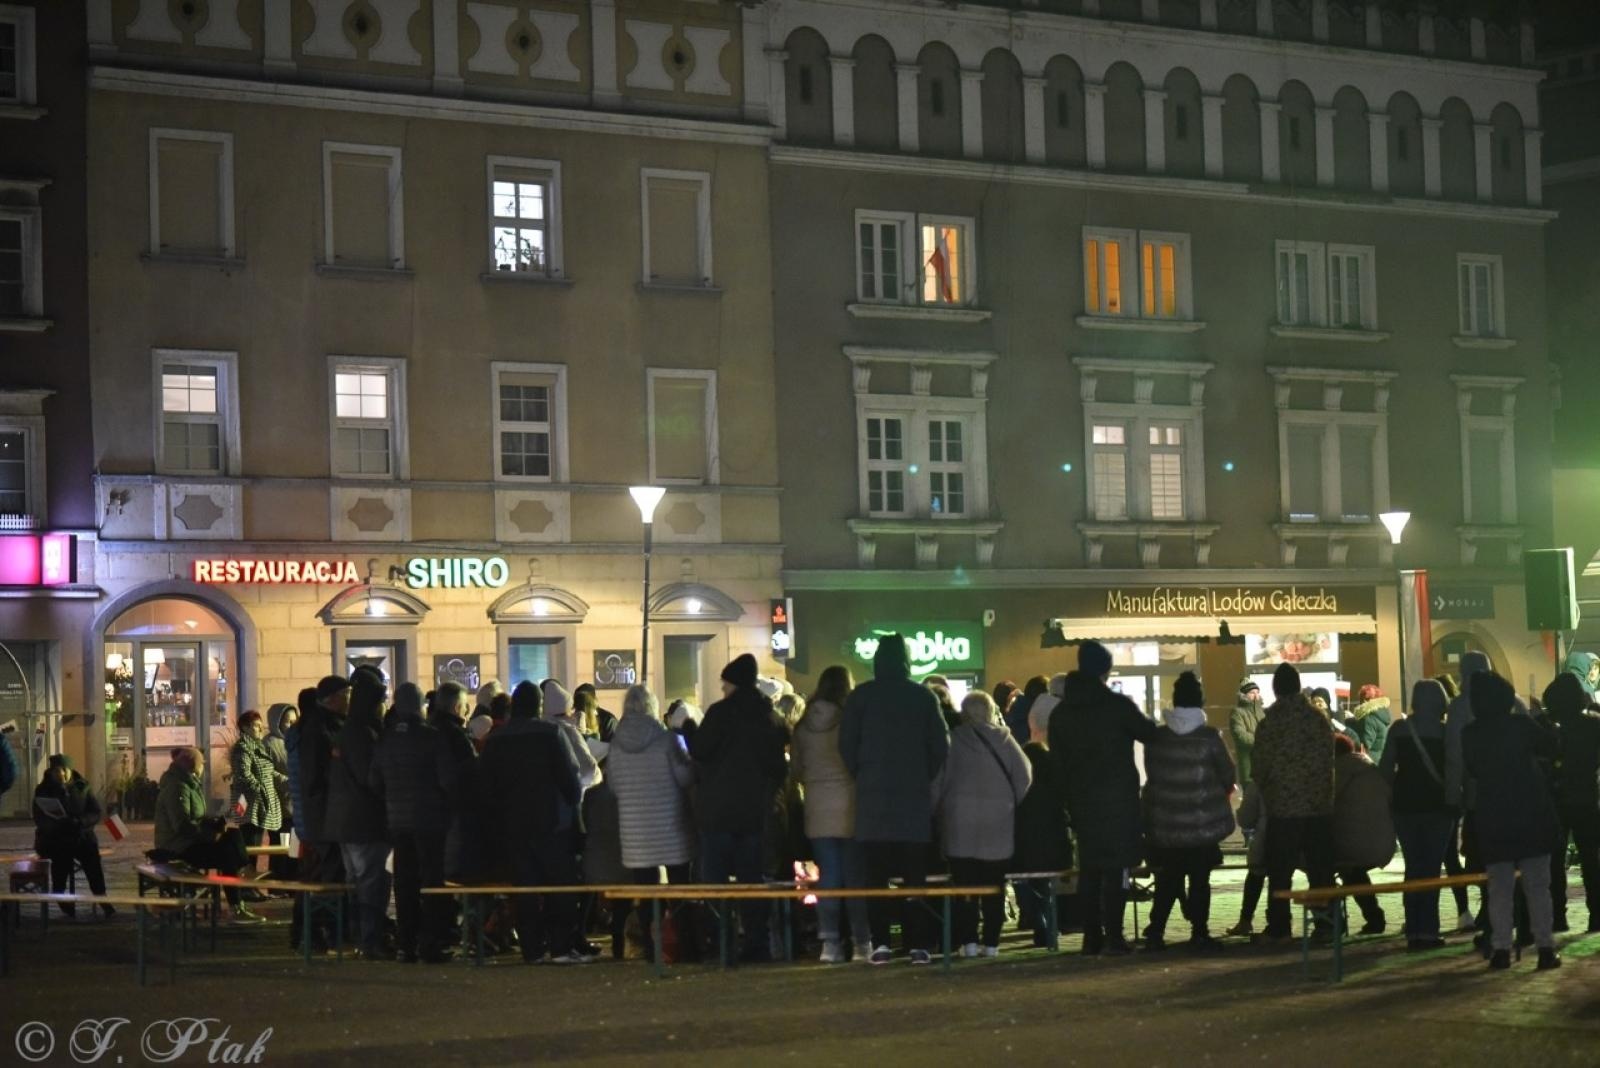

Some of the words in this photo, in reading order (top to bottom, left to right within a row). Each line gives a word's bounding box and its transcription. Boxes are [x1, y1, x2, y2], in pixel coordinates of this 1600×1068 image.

[194, 560, 360, 585] RESTAURACJA
[408, 556, 509, 589] SHIRO
[1106, 587, 1206, 614] Manufaktura
[1211, 589, 1265, 614] Lodów
[1271, 586, 1337, 613] Gałeczka
